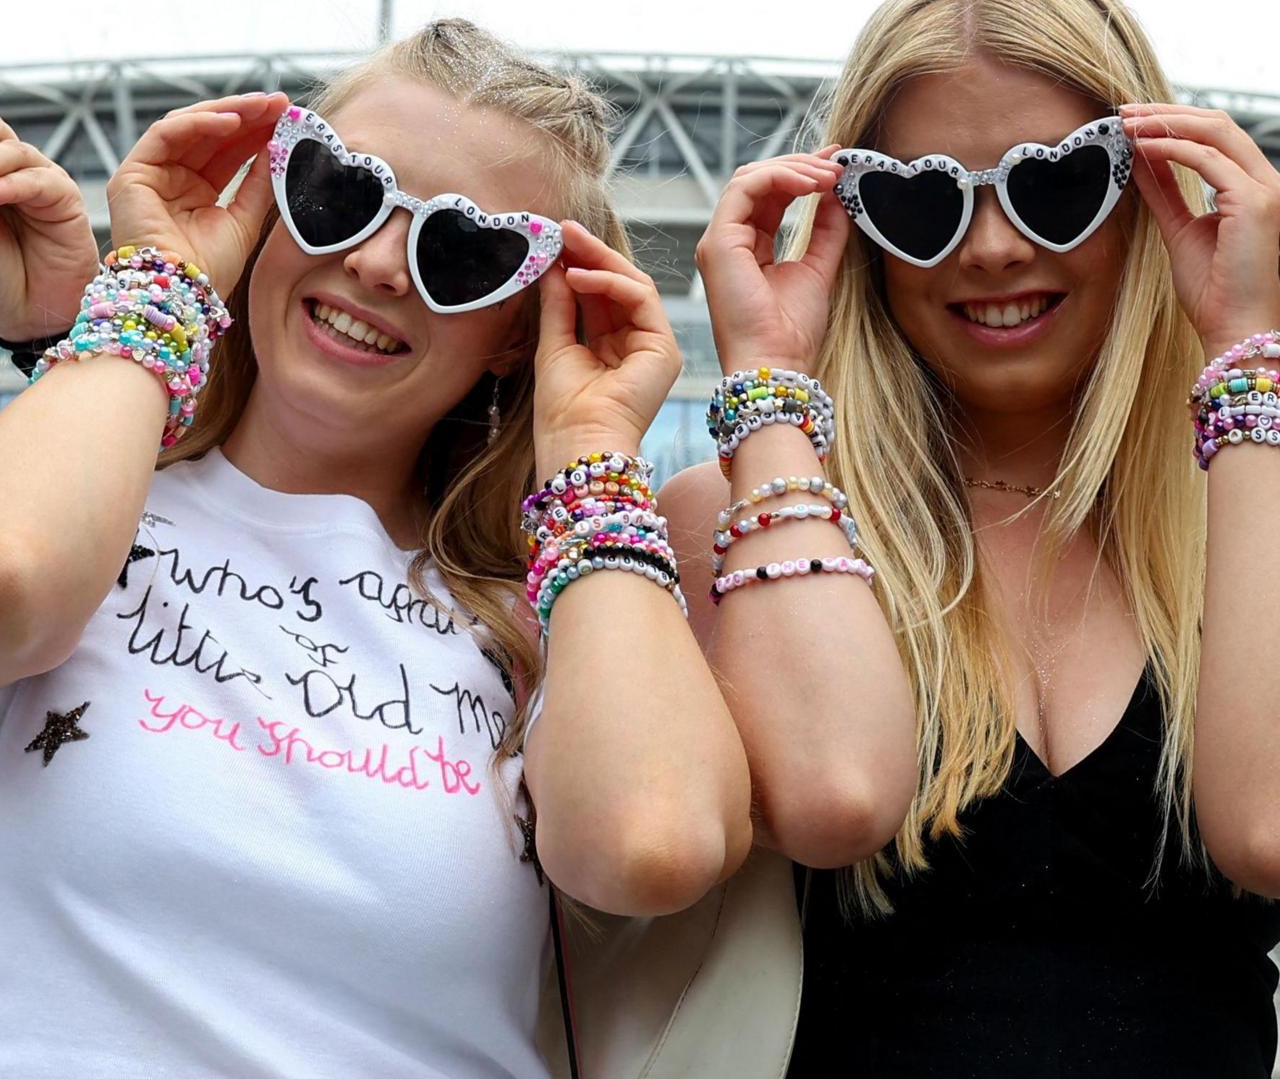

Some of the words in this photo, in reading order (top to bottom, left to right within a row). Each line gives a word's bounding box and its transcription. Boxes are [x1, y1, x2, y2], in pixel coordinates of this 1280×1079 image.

[303, 111, 343, 154] ERAS
[348, 153, 394, 187] TOUR
[453, 195, 532, 228] LONDON
[849, 153, 899, 174] ERAS
[910, 158, 961, 178] TOUR
[1021, 126, 1097, 160] LONDON
[339, 568, 485, 637] afrai
[136, 688, 248, 753] you
[423, 734, 483, 796] be
